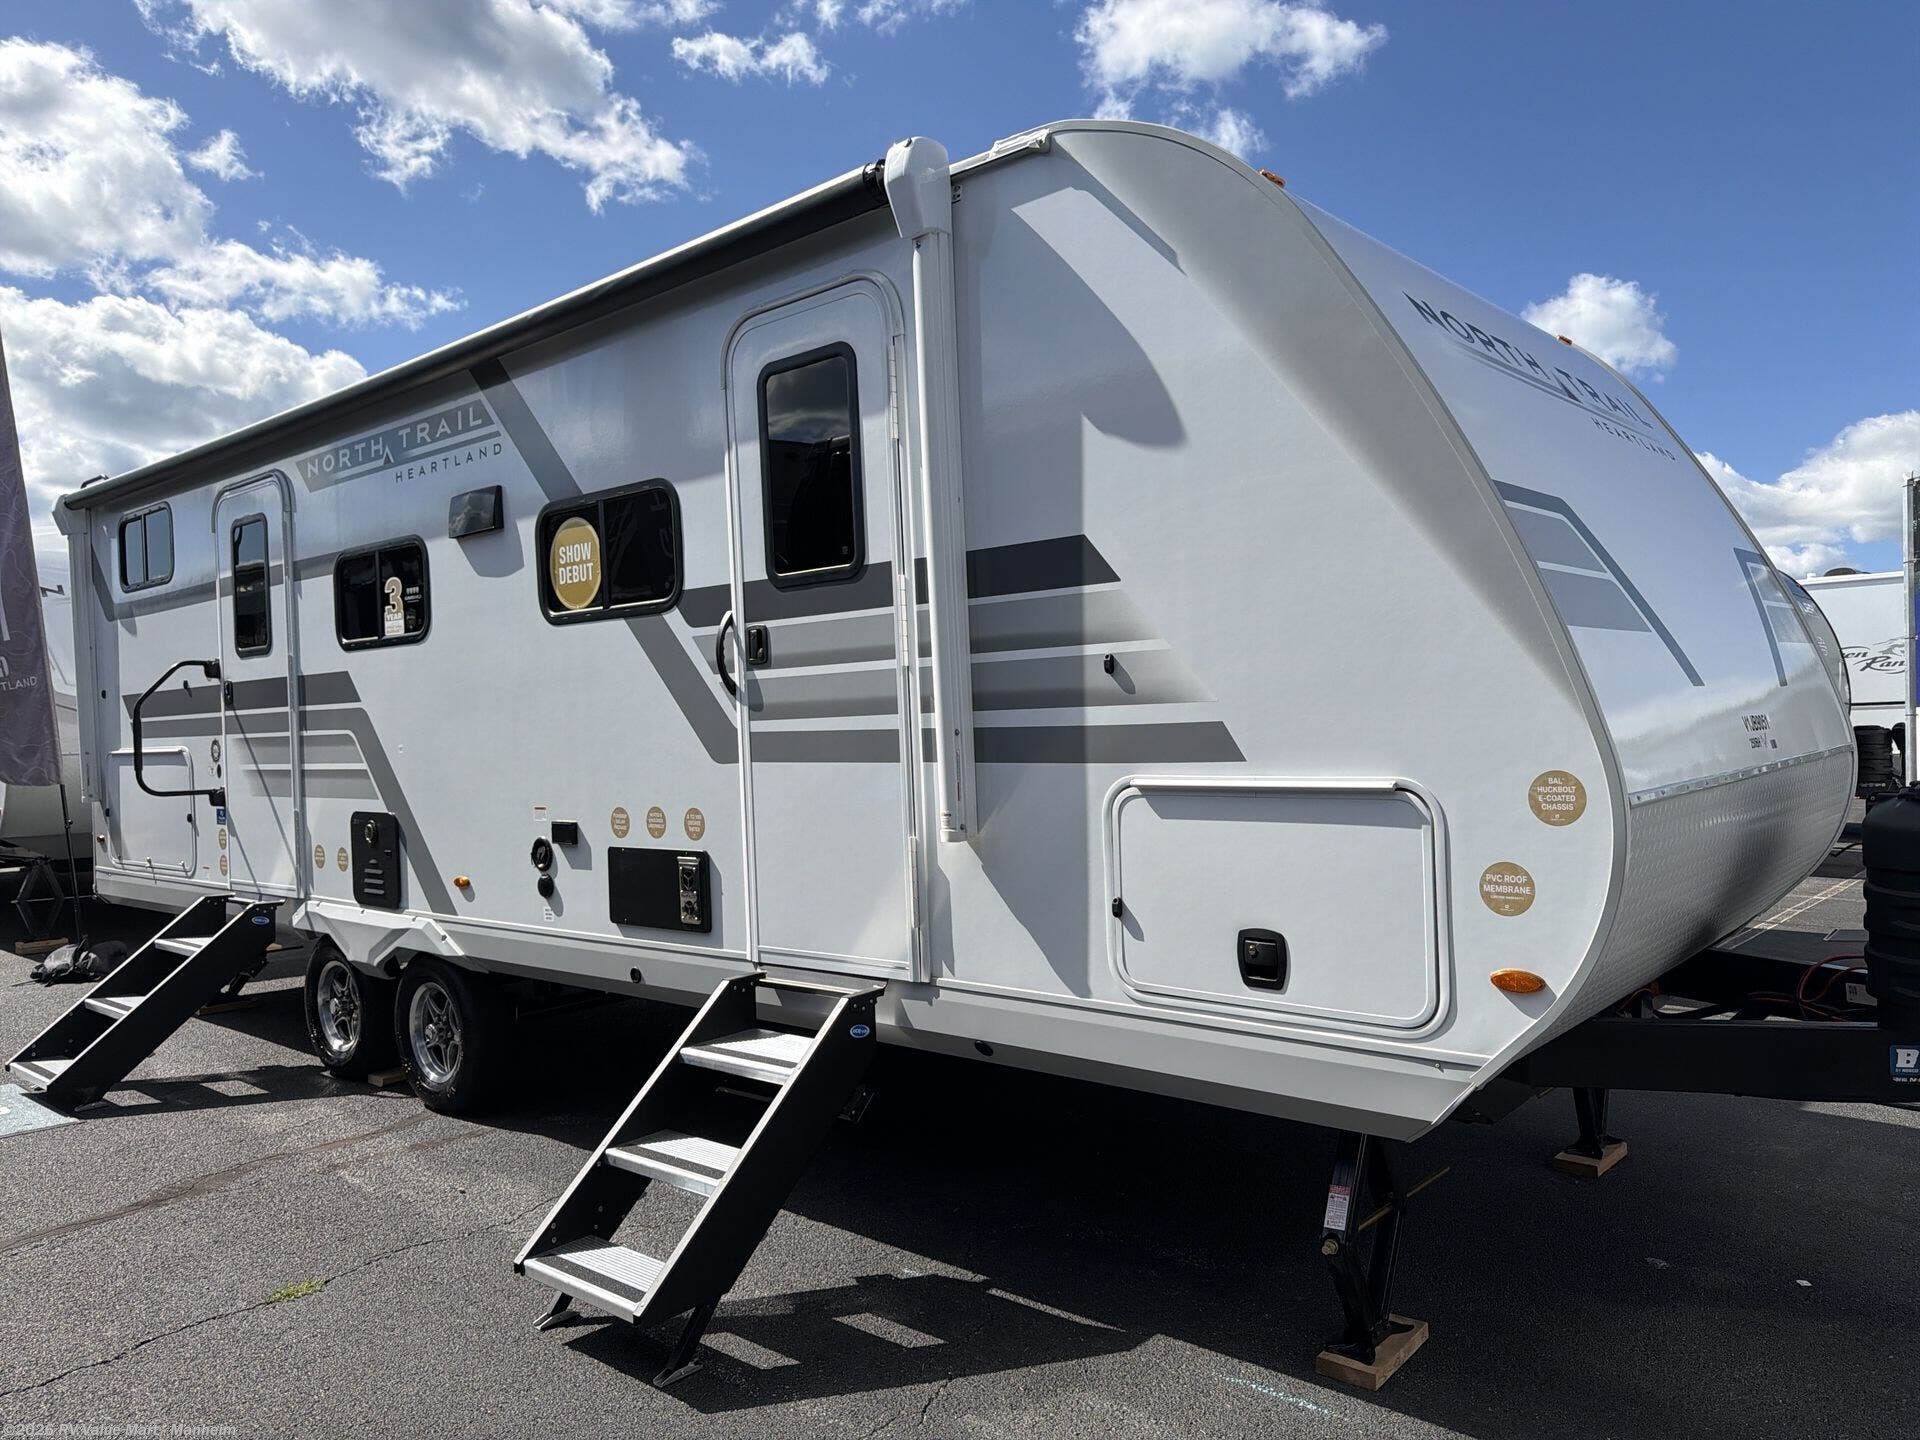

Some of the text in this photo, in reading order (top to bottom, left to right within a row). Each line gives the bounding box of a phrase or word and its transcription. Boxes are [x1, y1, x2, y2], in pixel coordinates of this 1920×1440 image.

[1402, 290, 1654, 429] NORTH TRAIL
[306, 406, 482, 478] NORTH TRAIL
[1591, 417, 1676, 461] HEARTLAND
[395, 443, 502, 483] HEARTLAND
[559, 542, 592, 564] SHOW
[559, 563, 594, 585] DEBUT
[385, 577, 404, 614] 3
[1538, 794, 1576, 802] E-COATED
[1541, 803, 1574, 811] CHASSIS
[1485, 873, 1528, 883] PVC ROOF
[1483, 884, 1531, 895] MEMBRANE
